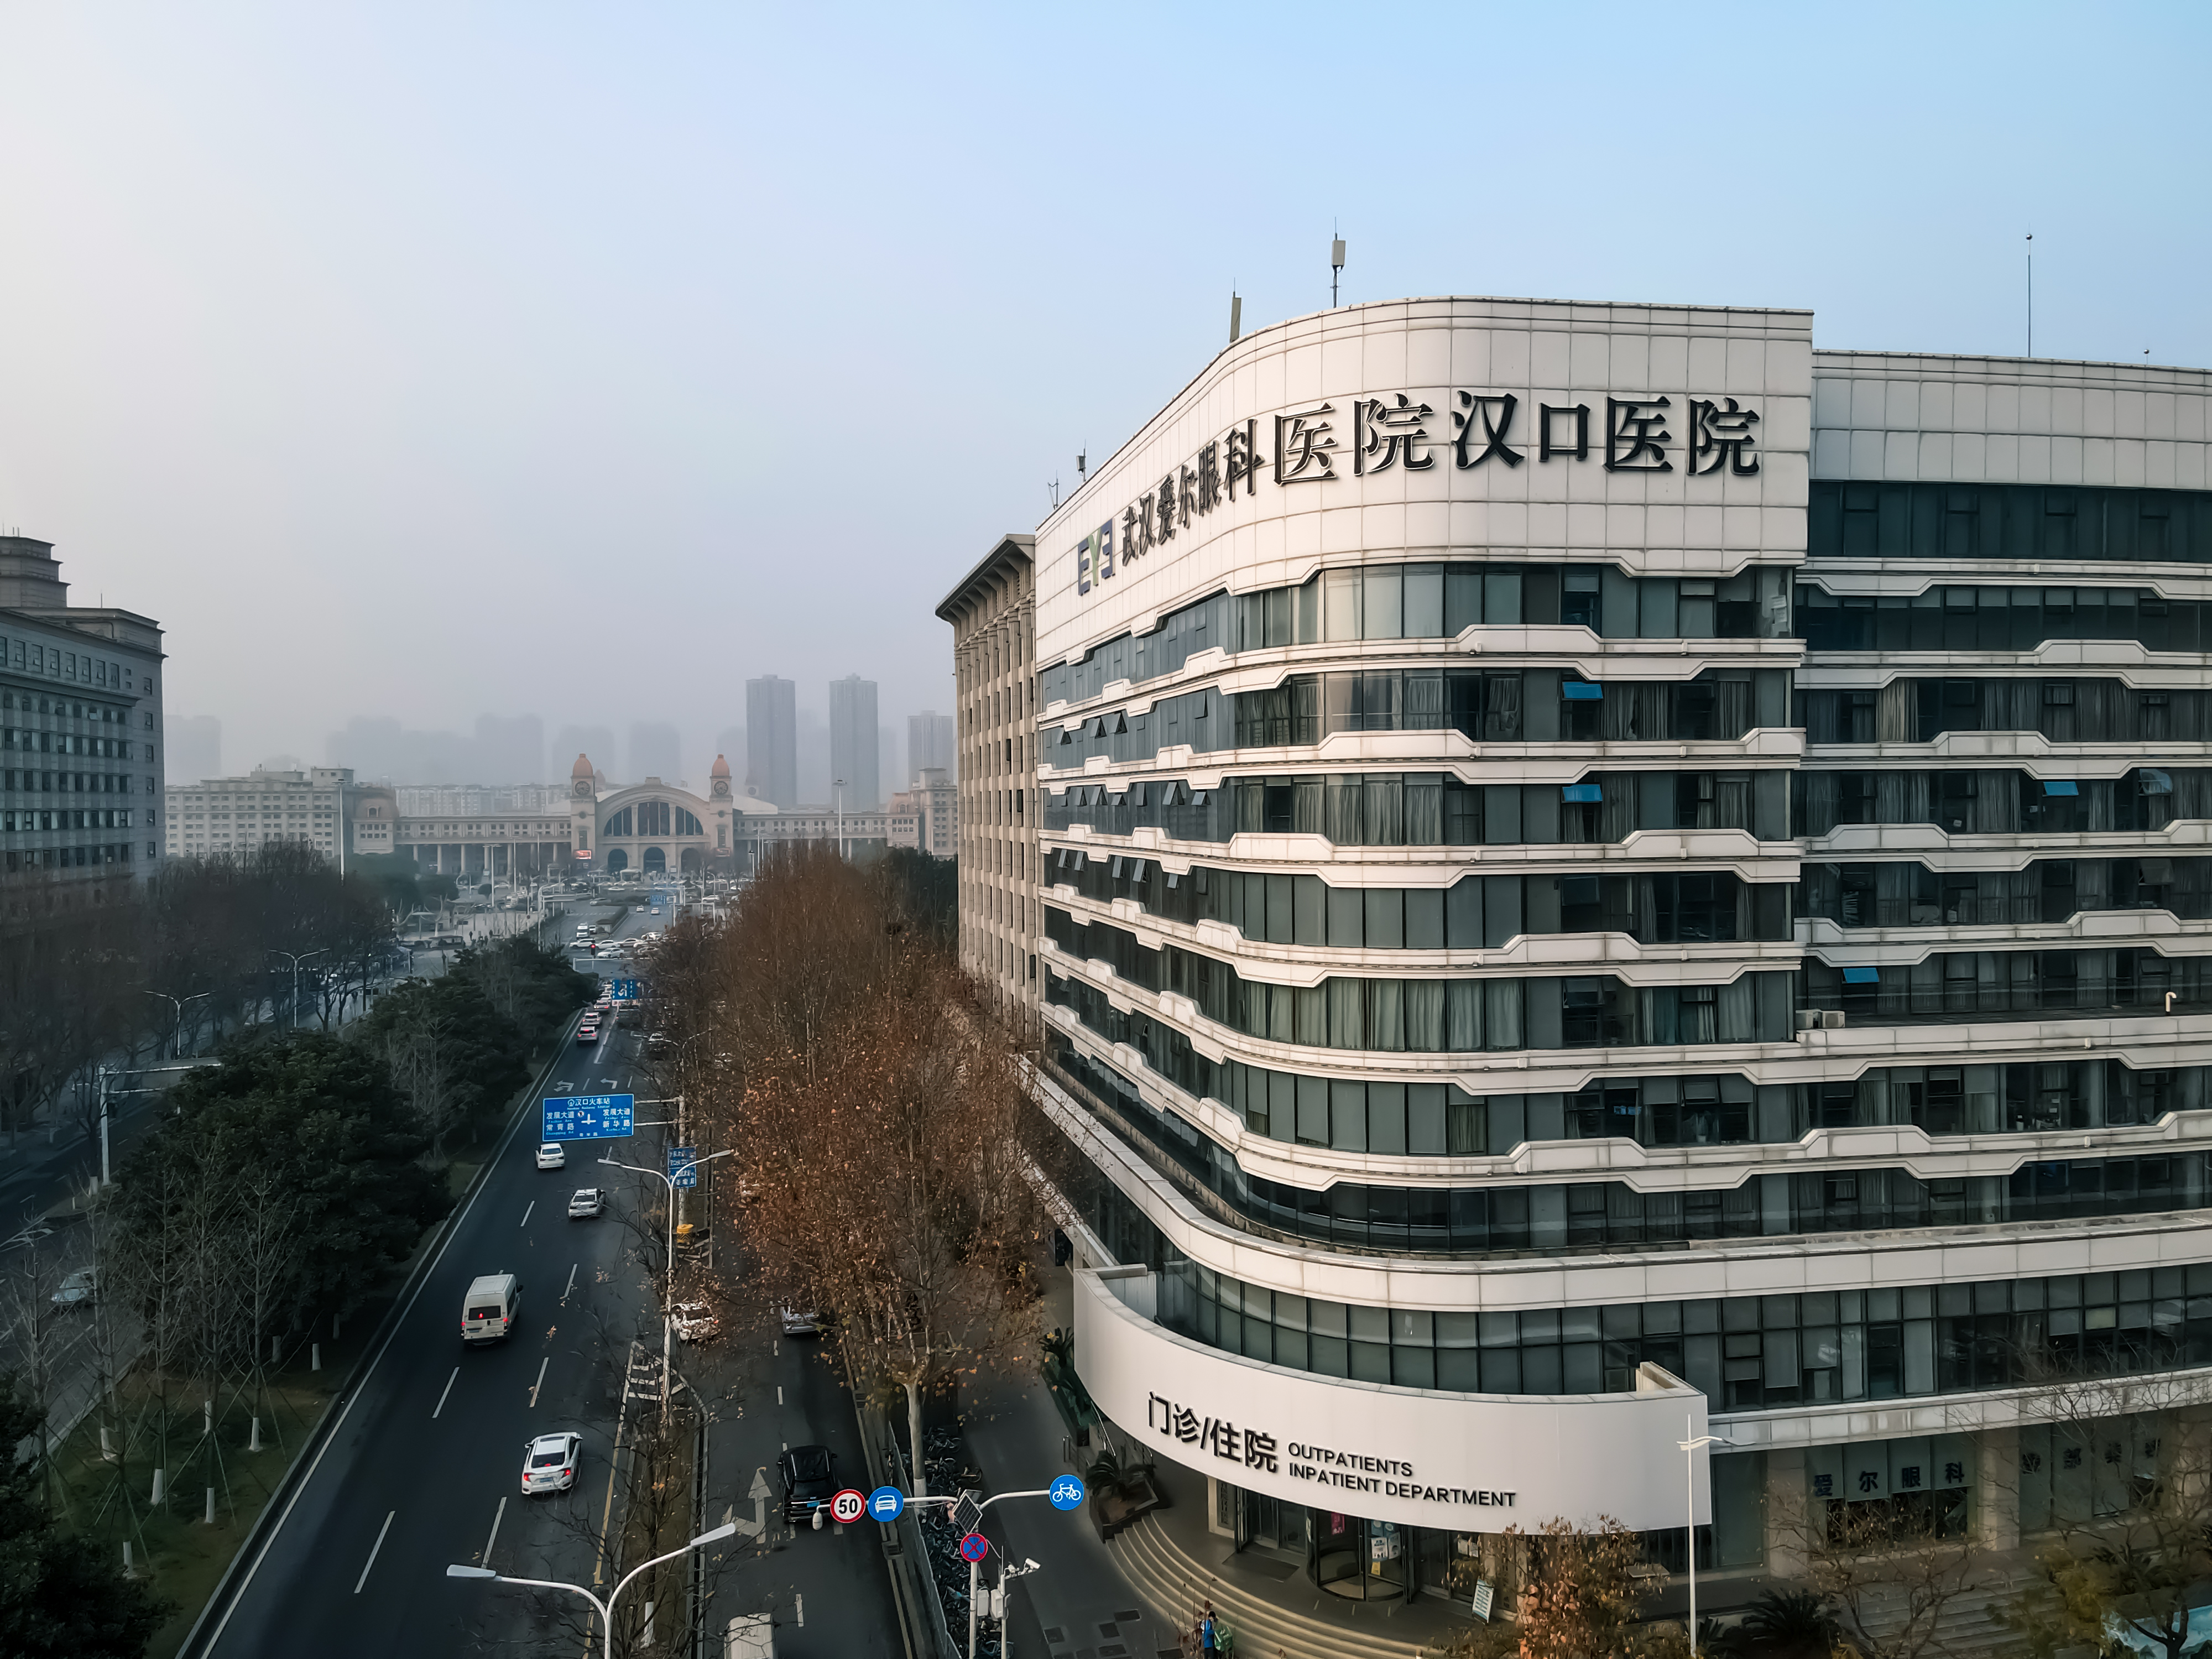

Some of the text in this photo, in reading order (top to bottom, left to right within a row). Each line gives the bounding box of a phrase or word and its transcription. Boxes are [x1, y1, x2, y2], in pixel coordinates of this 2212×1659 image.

[575, 1097, 611, 1106] 汉口火车站
[1148, 1391, 1278, 1474] 门诊/住院
[1288, 1442, 1413, 1477] OUTPATIENTS
[1290, 1462, 1516, 1507] INPATIENT DEPARTMENT
[1814, 1461, 1964, 1496] 爱尔眼科
[839, 1499, 858, 1514] 50
